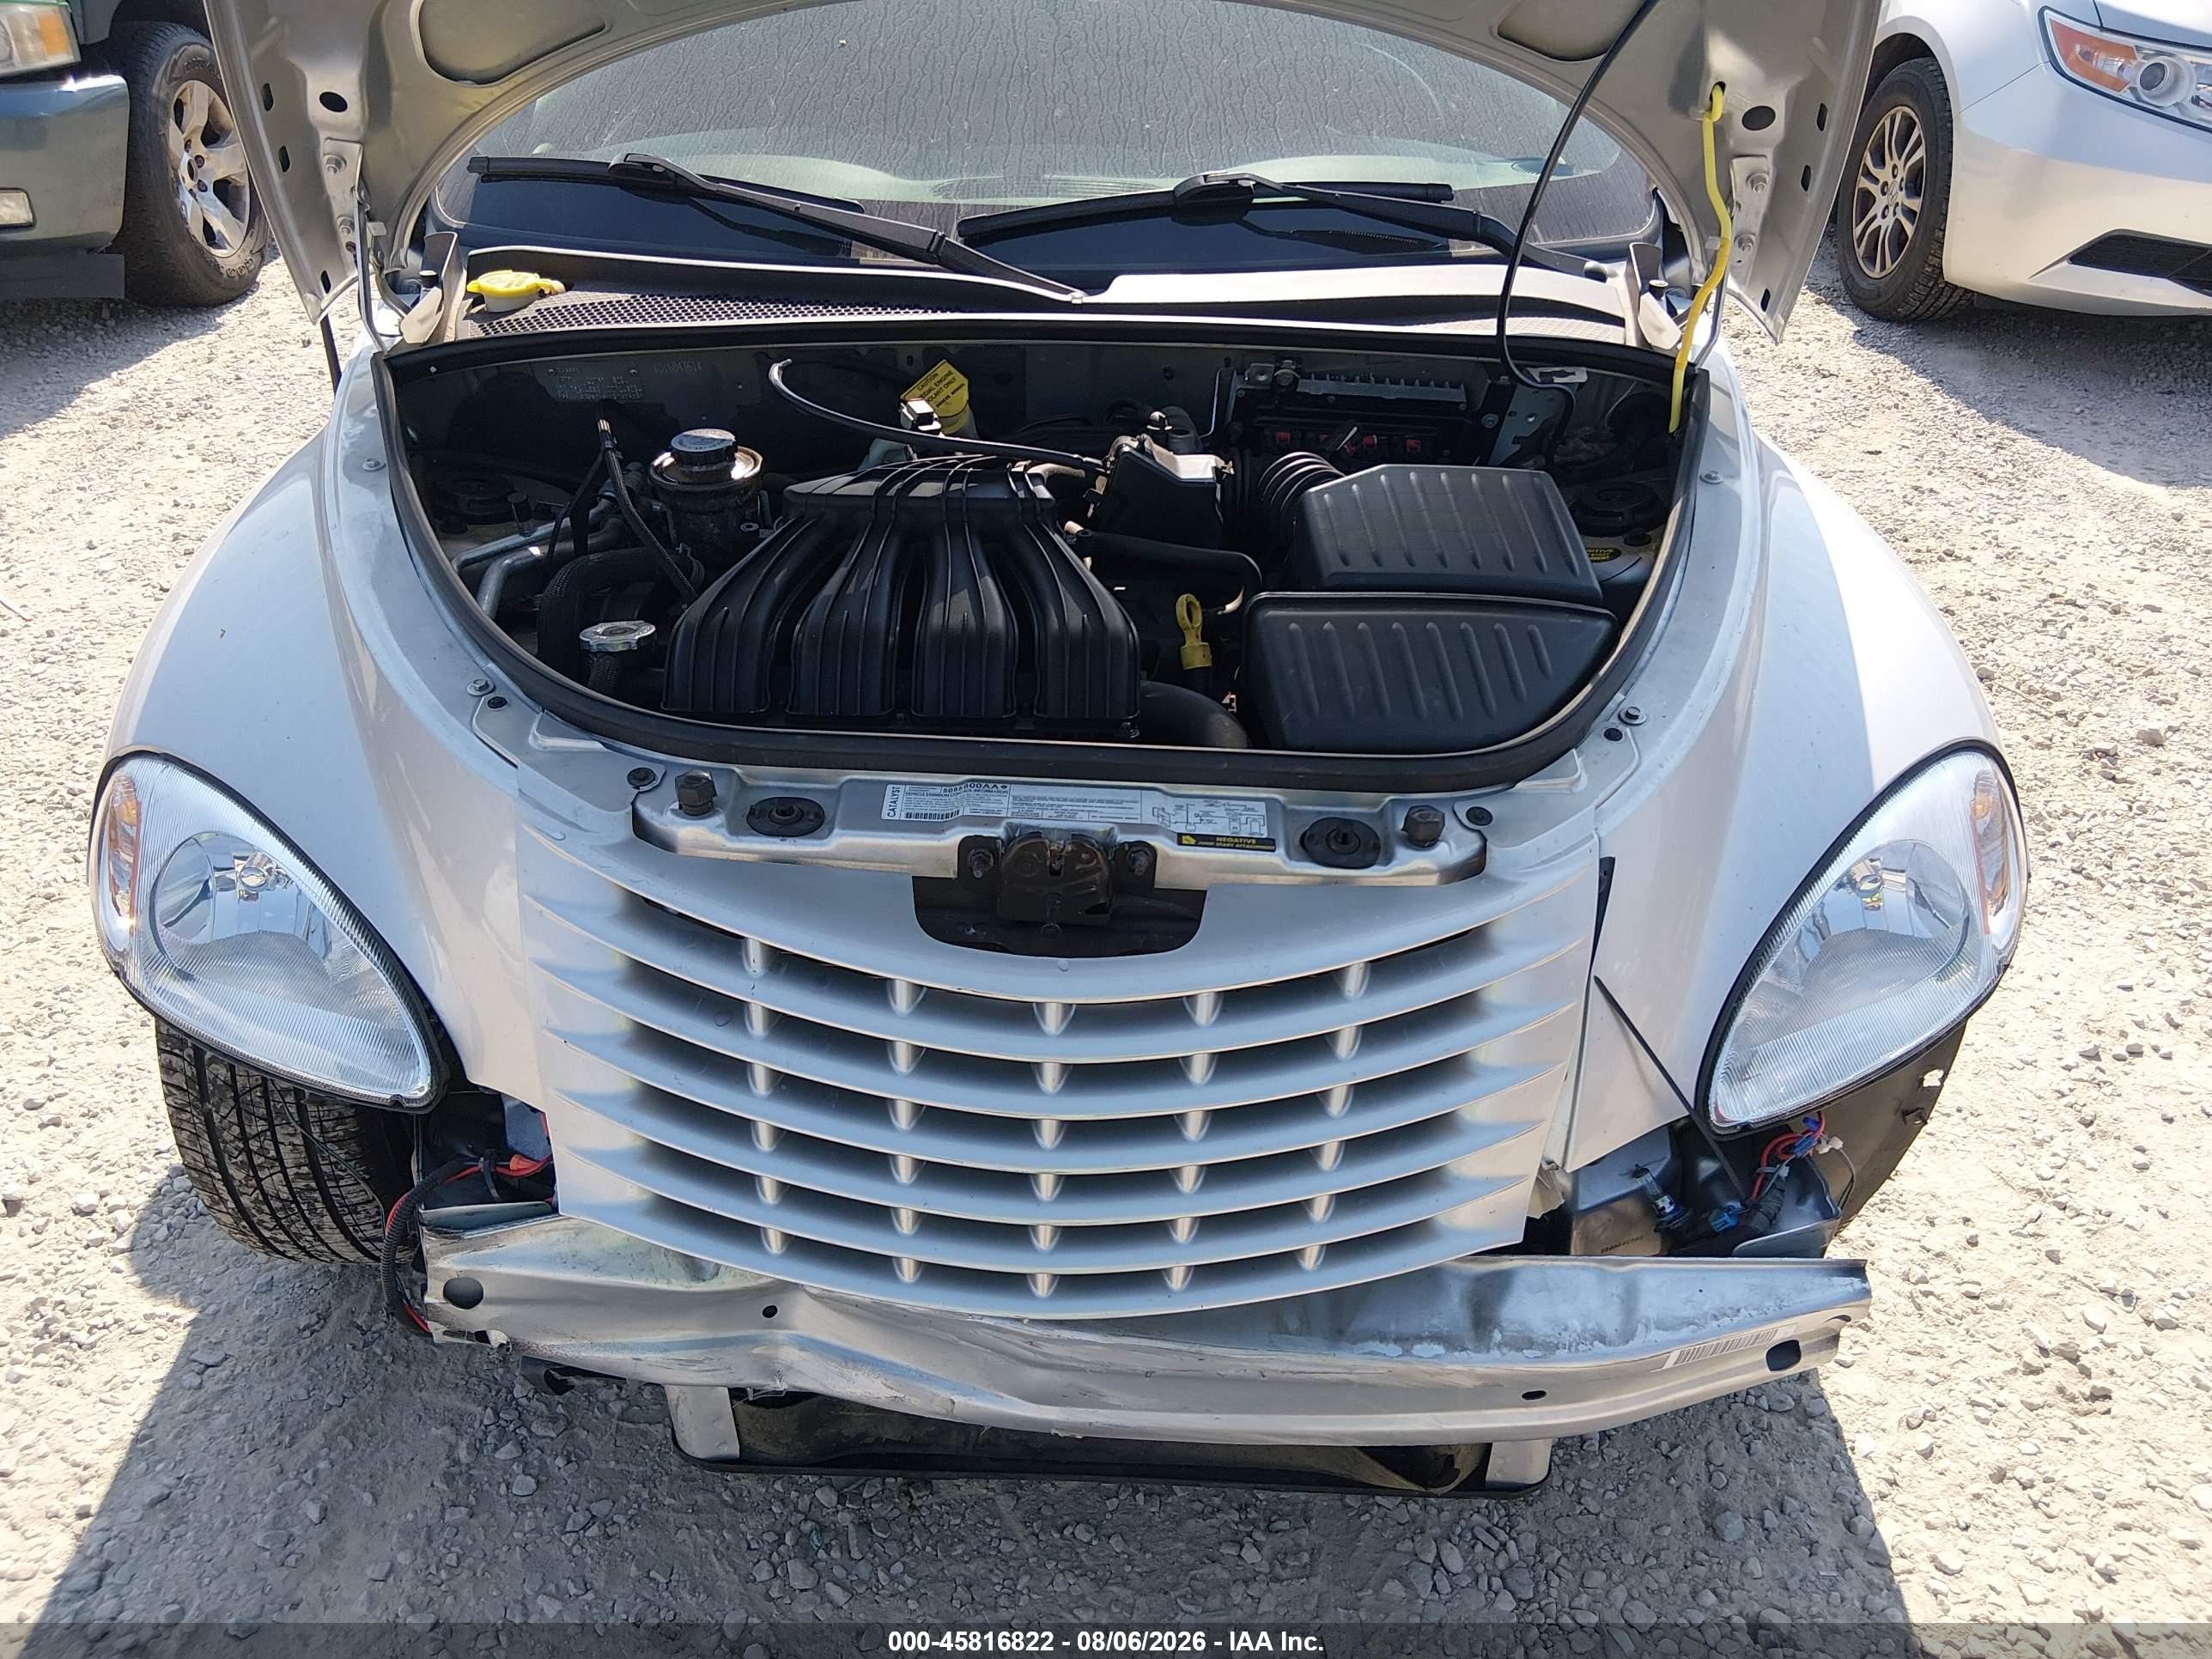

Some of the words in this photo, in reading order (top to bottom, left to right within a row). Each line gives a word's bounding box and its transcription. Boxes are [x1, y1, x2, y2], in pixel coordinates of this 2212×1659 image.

[917, 373, 939, 391] CAUTION
[934, 370, 953, 387] ENGINE
[927, 387, 944, 402] OLANT
[944, 377, 957, 389] ONLY
[887, 786, 900, 817] CATALYST
[1216, 836, 1256, 845] NEGATIVE
